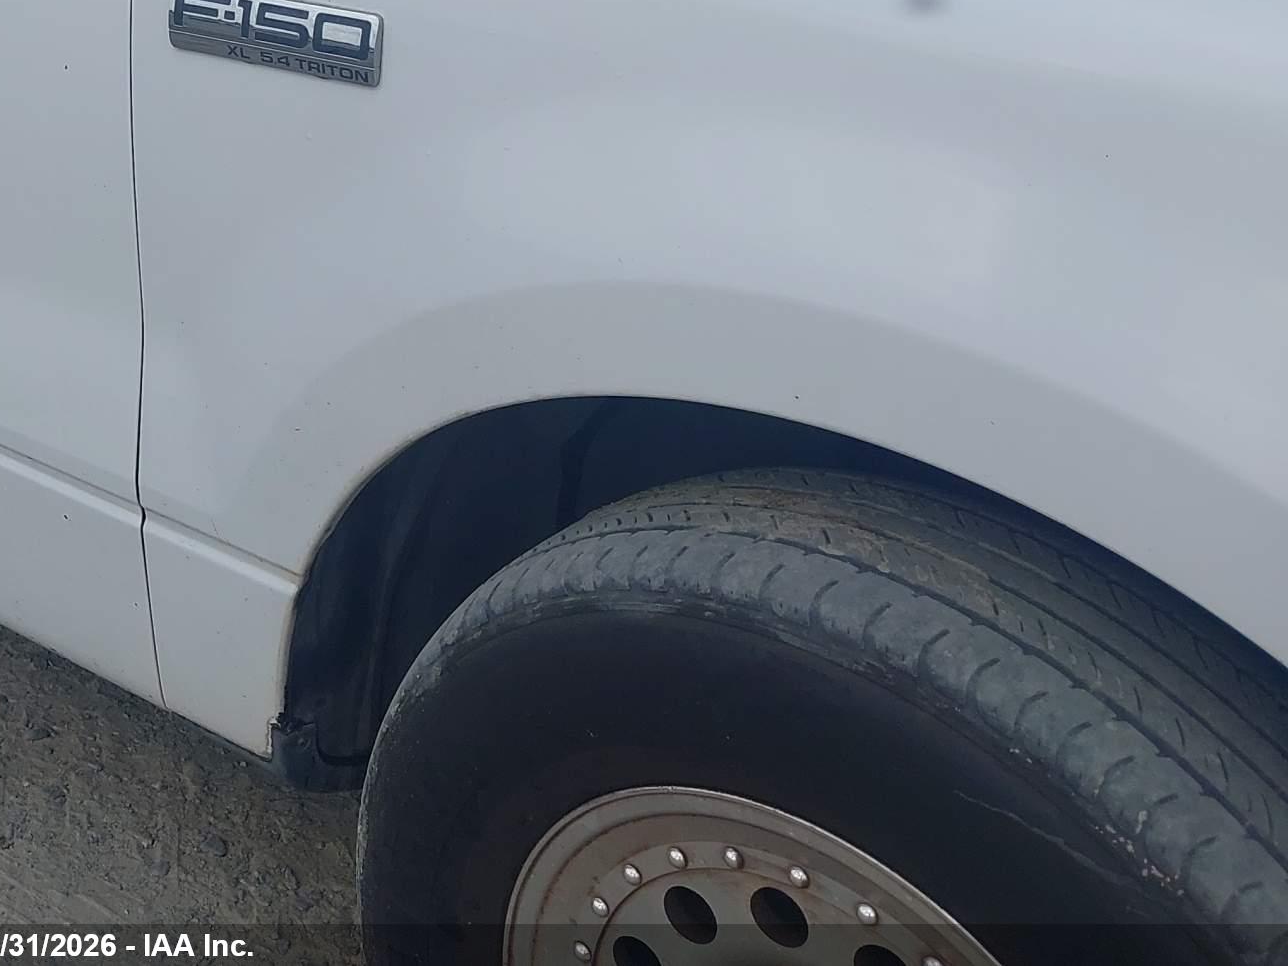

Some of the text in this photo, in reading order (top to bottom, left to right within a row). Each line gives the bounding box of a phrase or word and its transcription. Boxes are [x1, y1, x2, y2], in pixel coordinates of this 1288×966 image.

[227, 44, 370, 84] XL 5.4 TRITON
